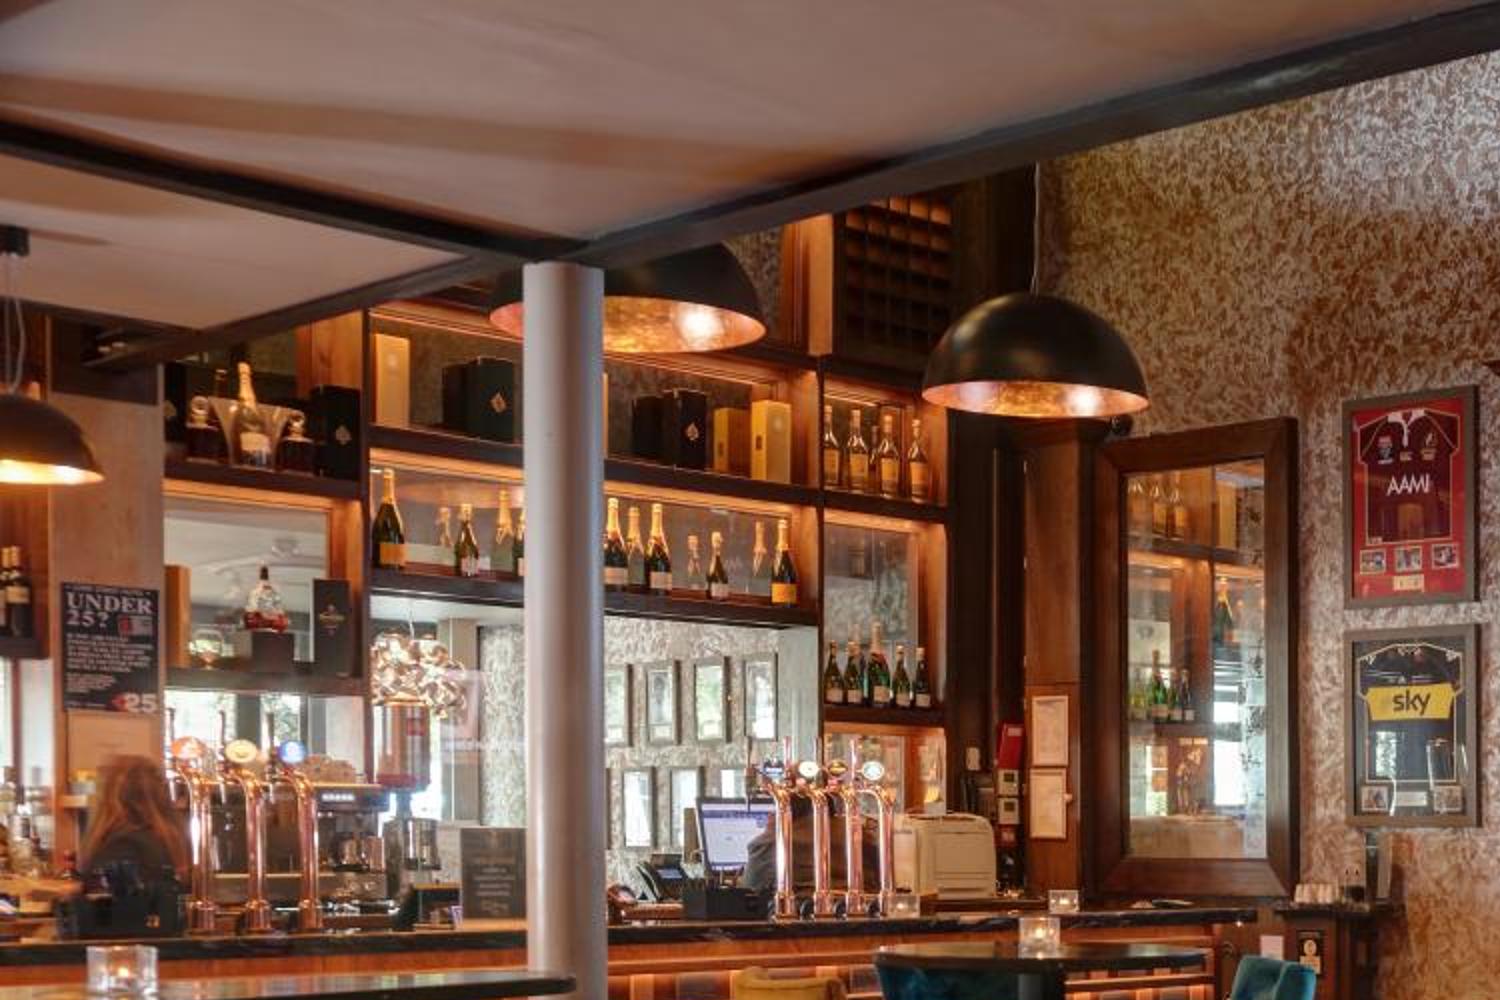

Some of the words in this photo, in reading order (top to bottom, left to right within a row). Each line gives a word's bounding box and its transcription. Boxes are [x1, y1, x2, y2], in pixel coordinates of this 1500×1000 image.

[1386, 474, 1430, 496] AAMI
[66, 592, 154, 614] UNDER
[66, 609, 109, 628] 25?
[1392, 688, 1431, 715] sky
